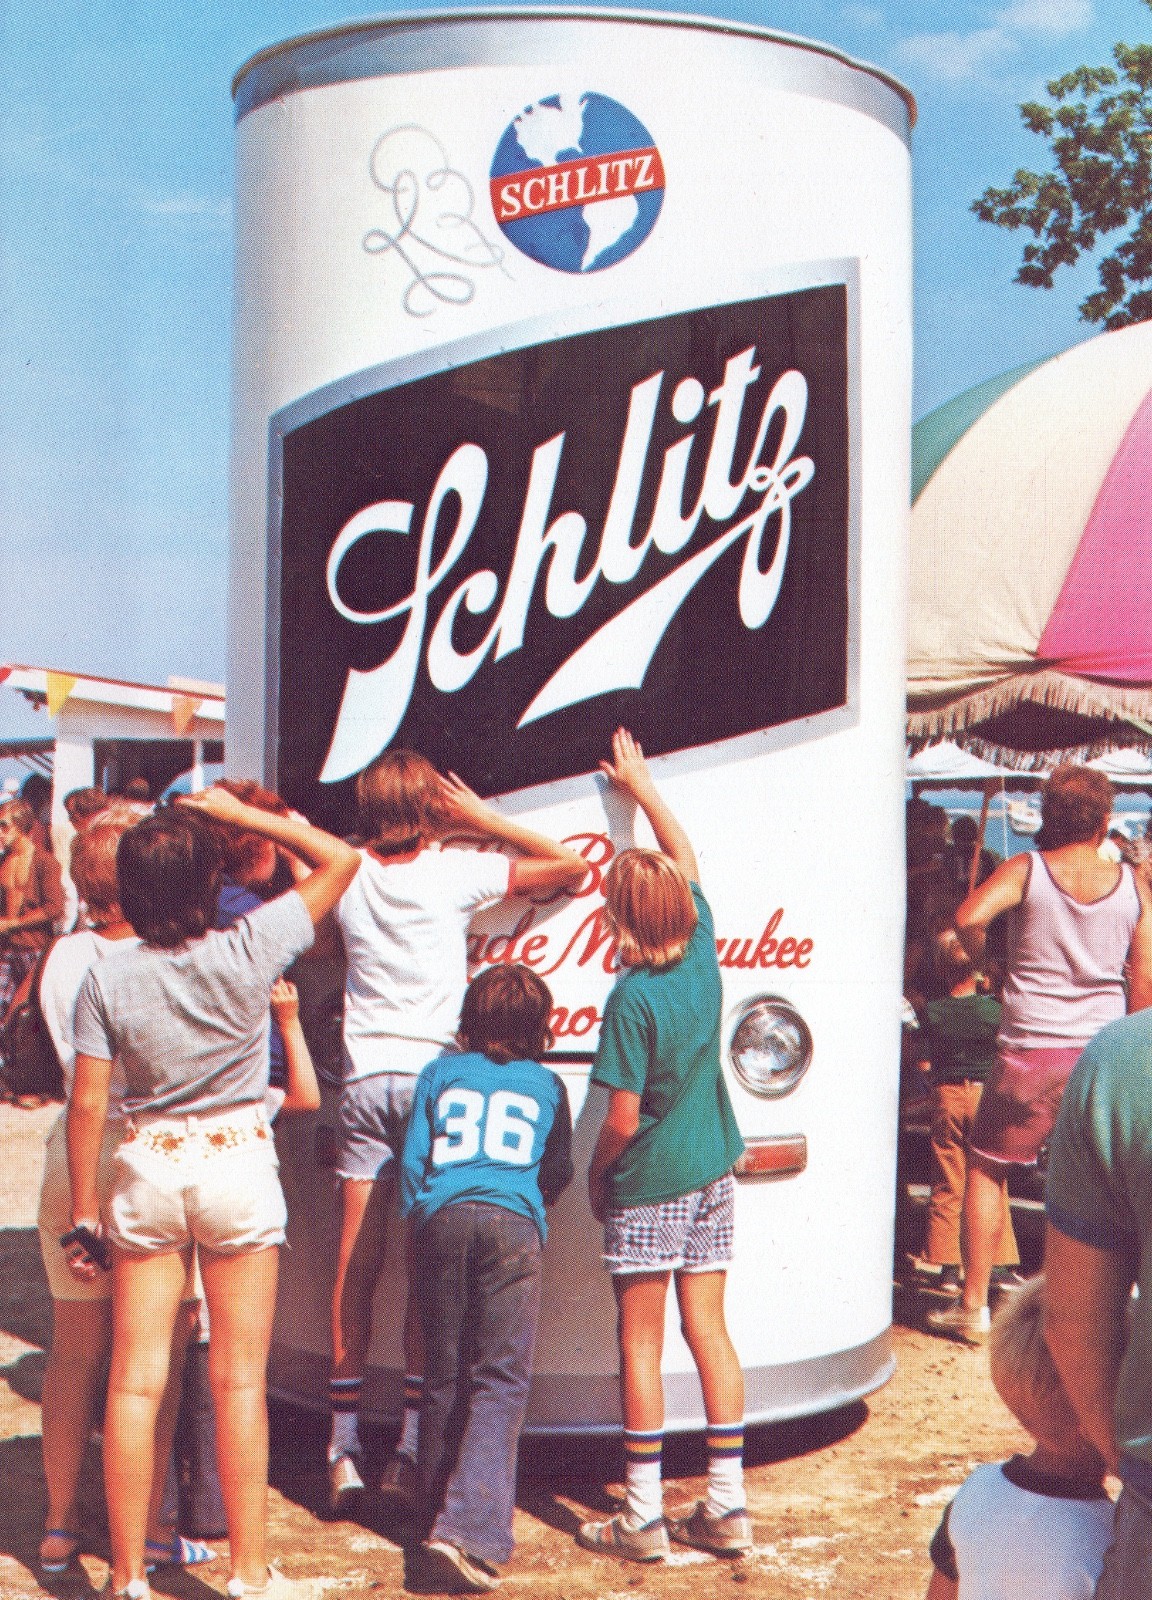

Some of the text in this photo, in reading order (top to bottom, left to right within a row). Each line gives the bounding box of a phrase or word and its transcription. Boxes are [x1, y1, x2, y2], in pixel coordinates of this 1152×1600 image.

[501, 155, 654, 217] SCHLITZ
[319, 345, 815, 783] Schlitz
[467, 907, 548, 967] ade
[432, 1087, 540, 1166] 36
